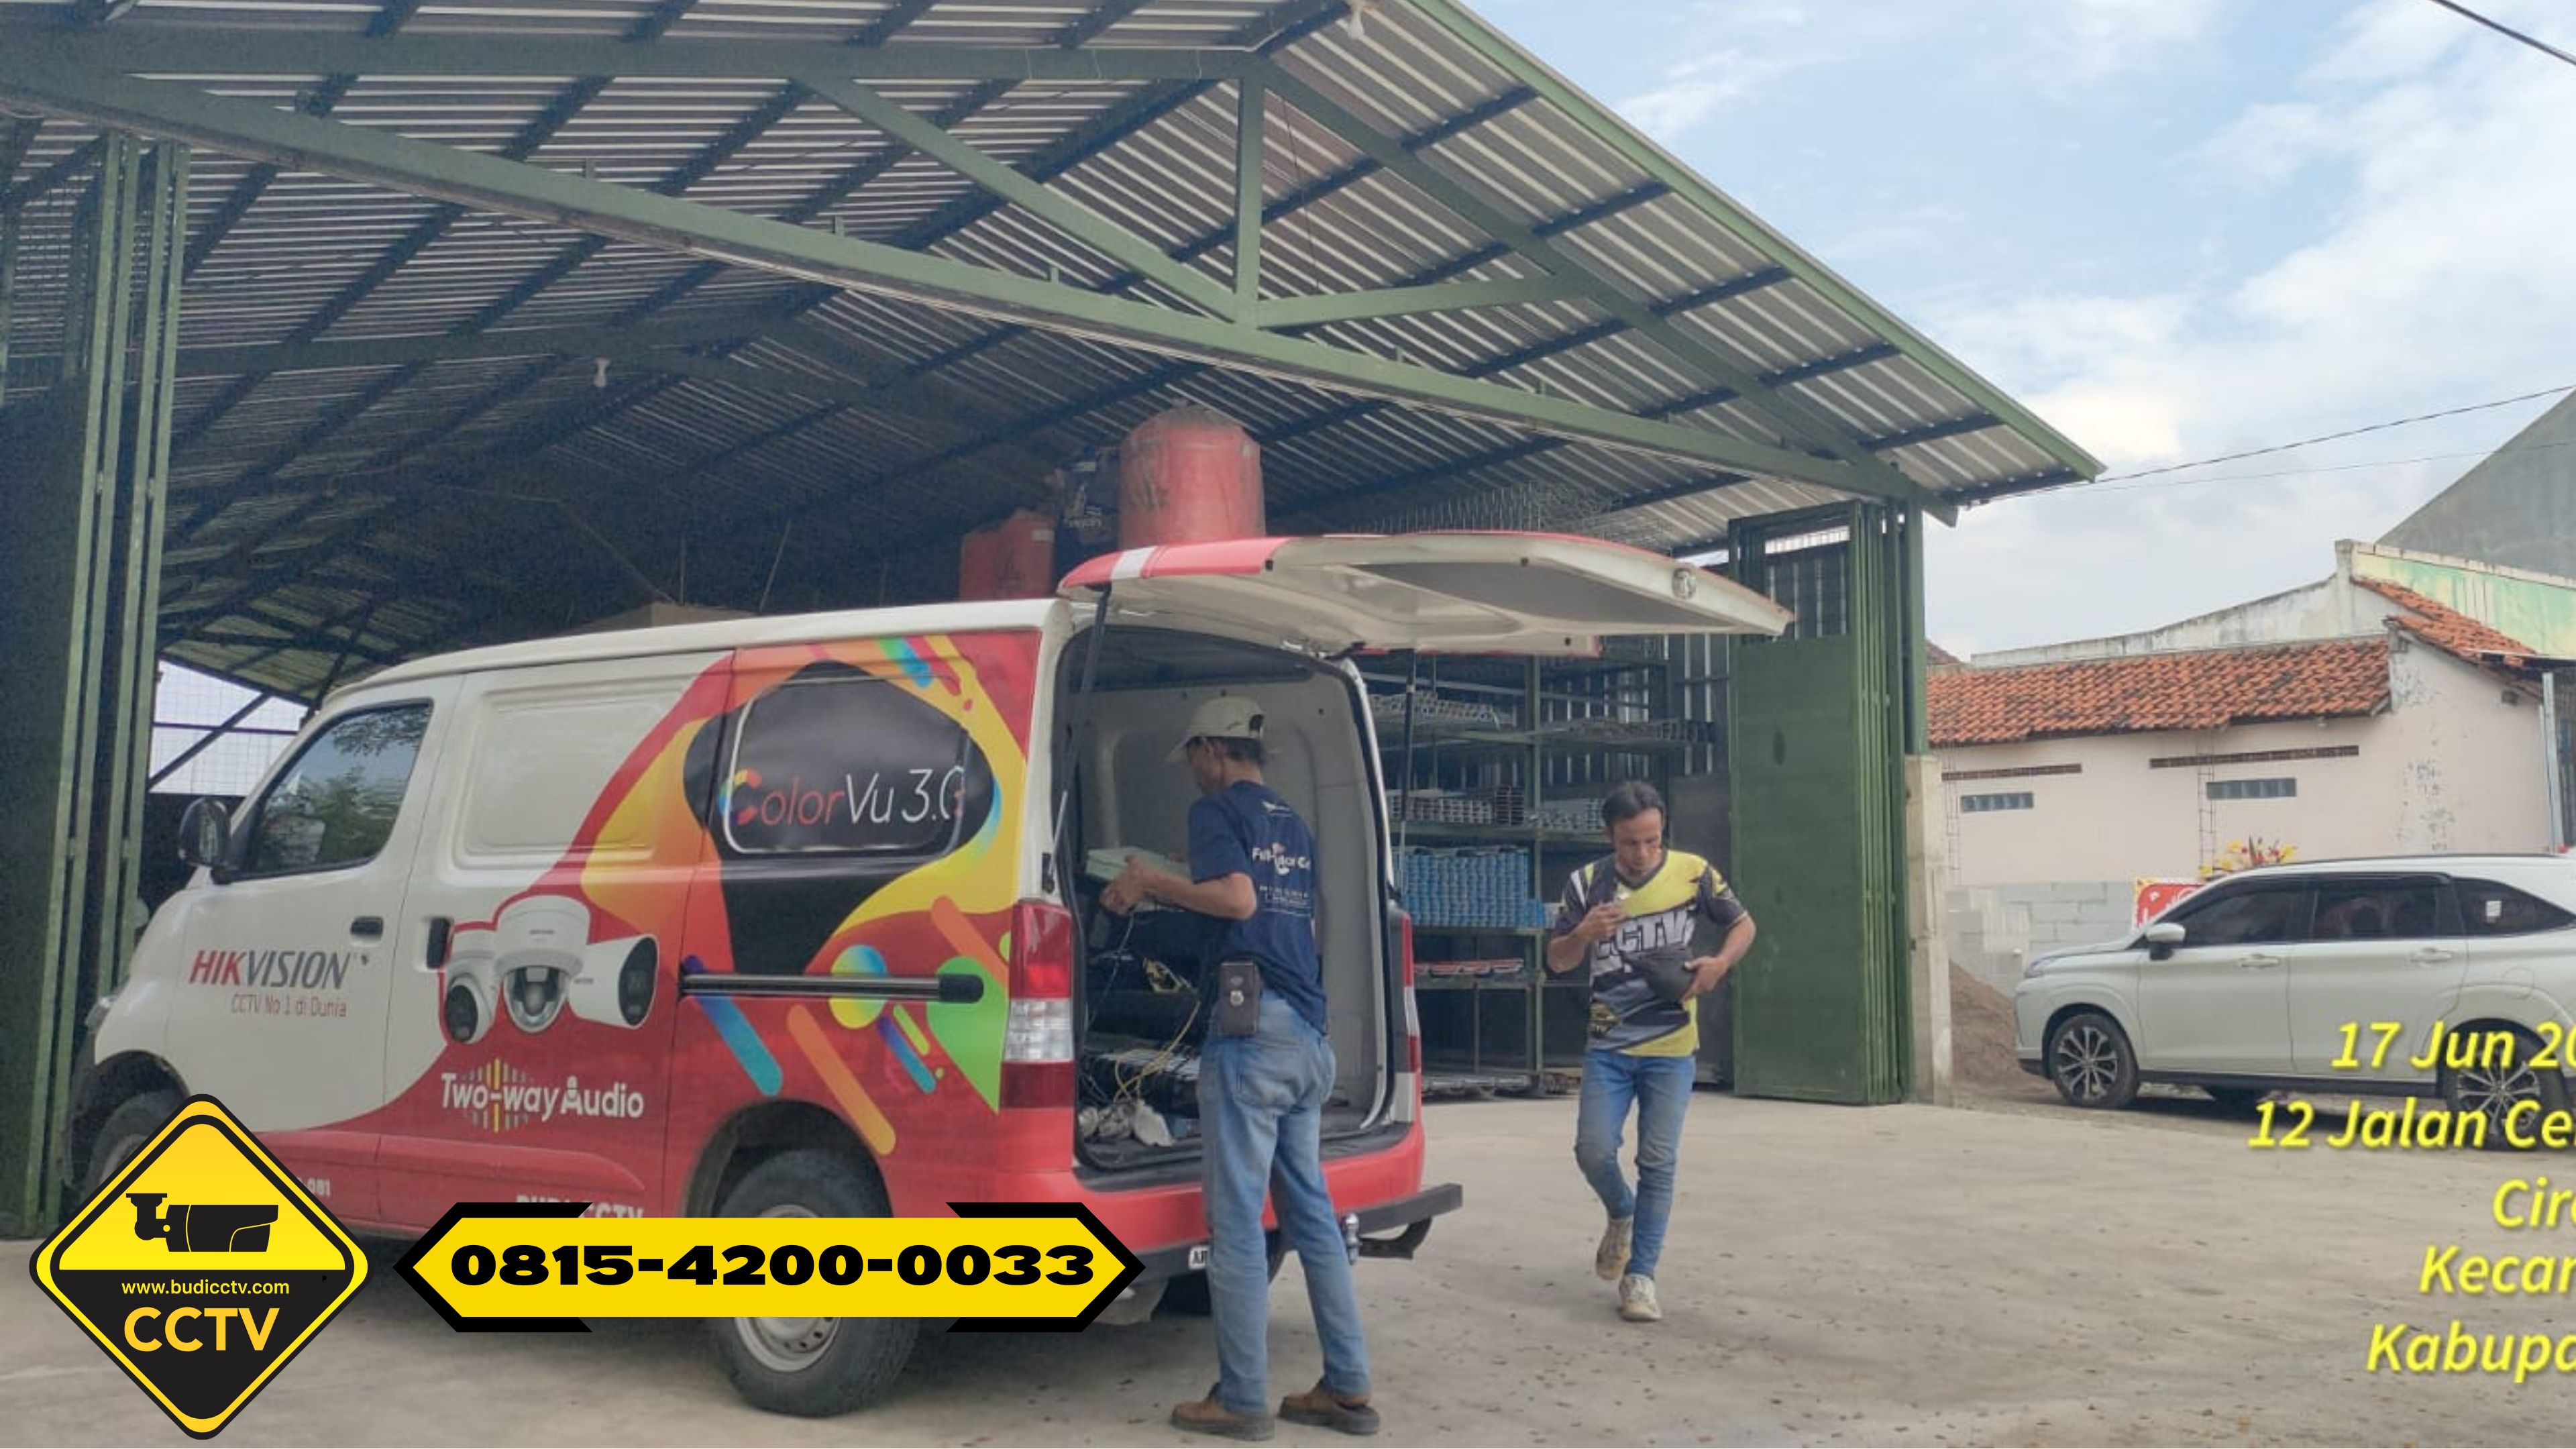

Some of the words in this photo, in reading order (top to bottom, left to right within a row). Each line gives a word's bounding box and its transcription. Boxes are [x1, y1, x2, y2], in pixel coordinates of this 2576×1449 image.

[718, 769, 895, 825] ColorVu
[189, 949, 351, 990] HIKVISION
[231, 994, 262, 1014] CCTV
[264, 994, 281, 1015] No
[284, 994, 290, 1016] 1
[311, 995, 347, 1018] Dunia
[559, 1075, 644, 1118] Audio
